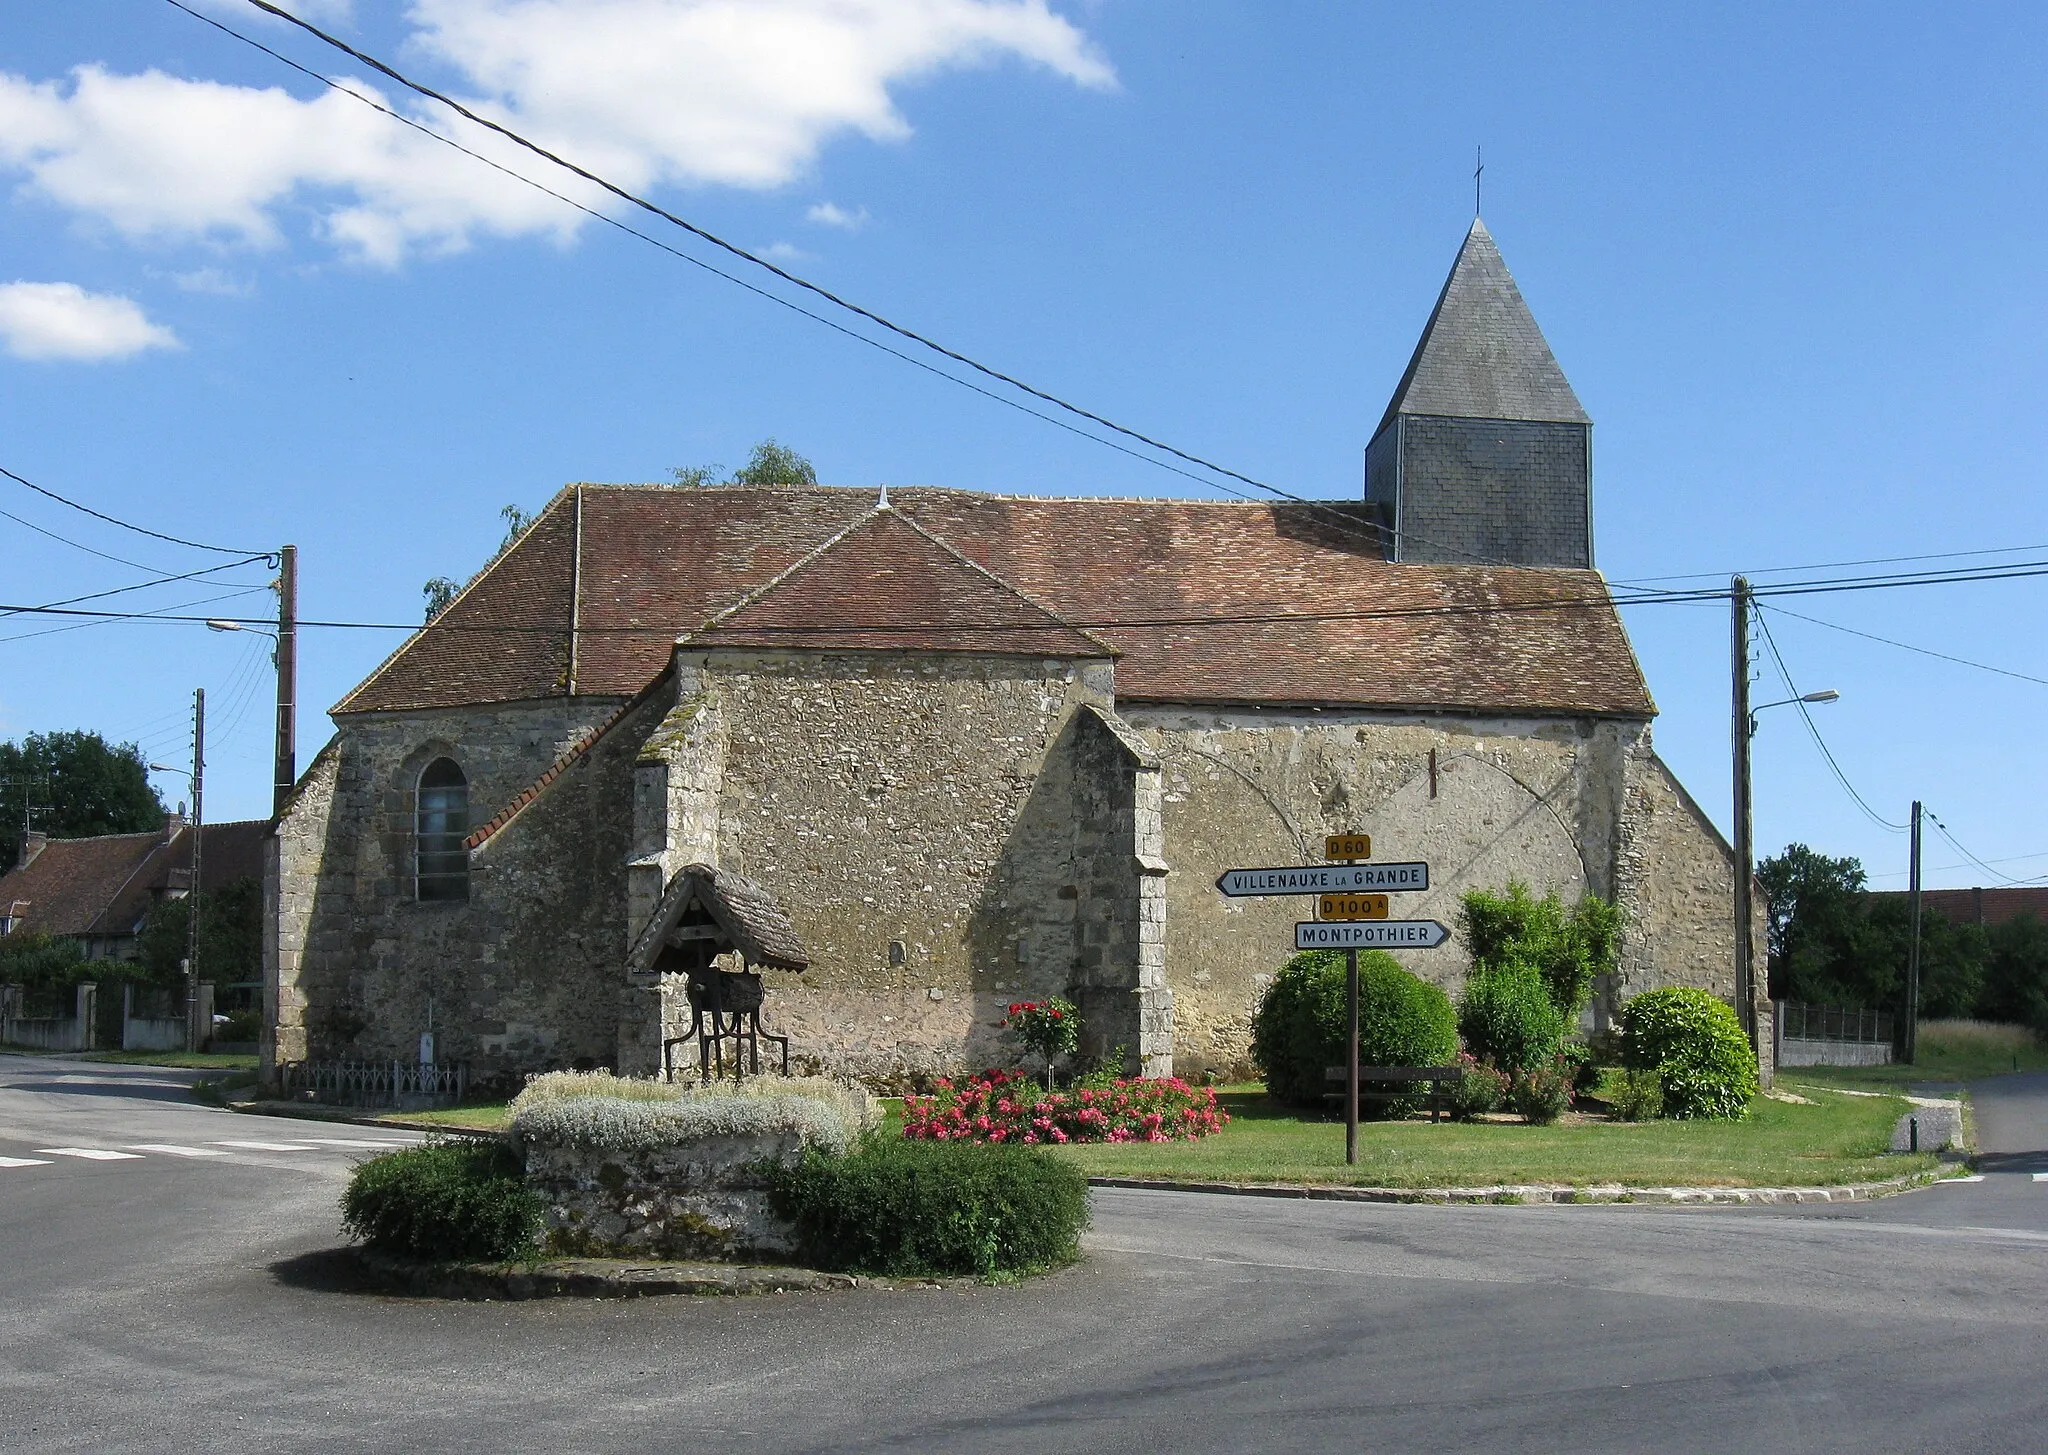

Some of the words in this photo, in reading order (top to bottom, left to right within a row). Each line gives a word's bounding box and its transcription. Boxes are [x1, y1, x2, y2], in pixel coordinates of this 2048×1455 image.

[1331, 841, 1339, 855] D
[1344, 841, 1364, 854] 60
[1233, 872, 1329, 889] VILLENAUXE
[1335, 876, 1347, 886] LA
[1354, 869, 1420, 885] GRANDE
[1323, 900, 1333, 914] D
[1340, 900, 1371, 914] 100
[1302, 927, 1429, 942] MONTPOTHIER
